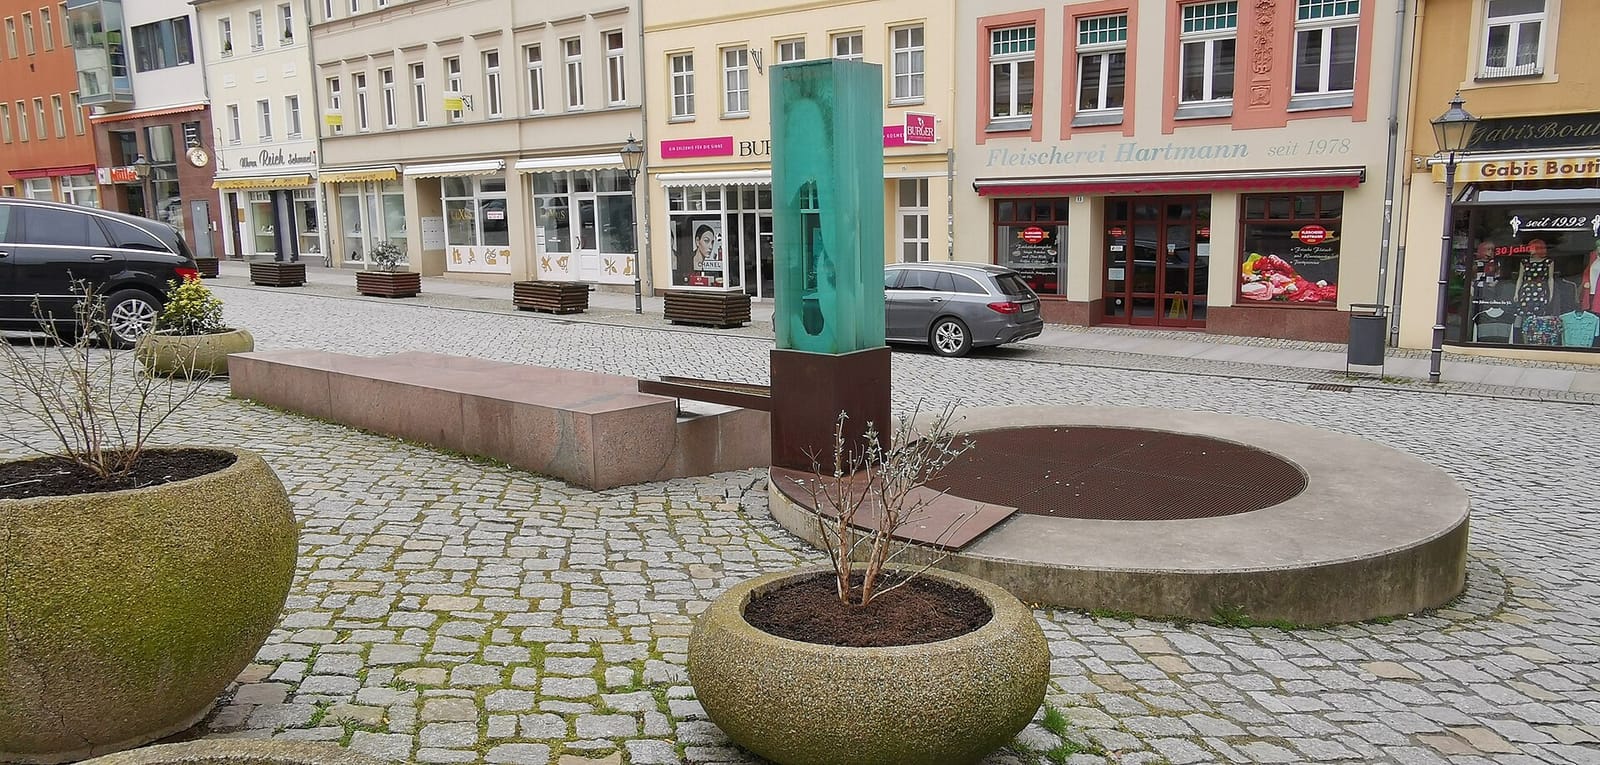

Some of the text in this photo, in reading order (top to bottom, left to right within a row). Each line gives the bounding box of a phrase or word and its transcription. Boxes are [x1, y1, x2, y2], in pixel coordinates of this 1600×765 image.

[908, 127, 933, 136] BURGER
[259, 148, 285, 166] Reich
[986, 138, 1351, 167] Fleischerei Hartmann seit 1978
[1481, 161, 1538, 177] Gabis
[1525, 216, 1586, 228] seit 1992
[1495, 246, 1507, 256] 30
